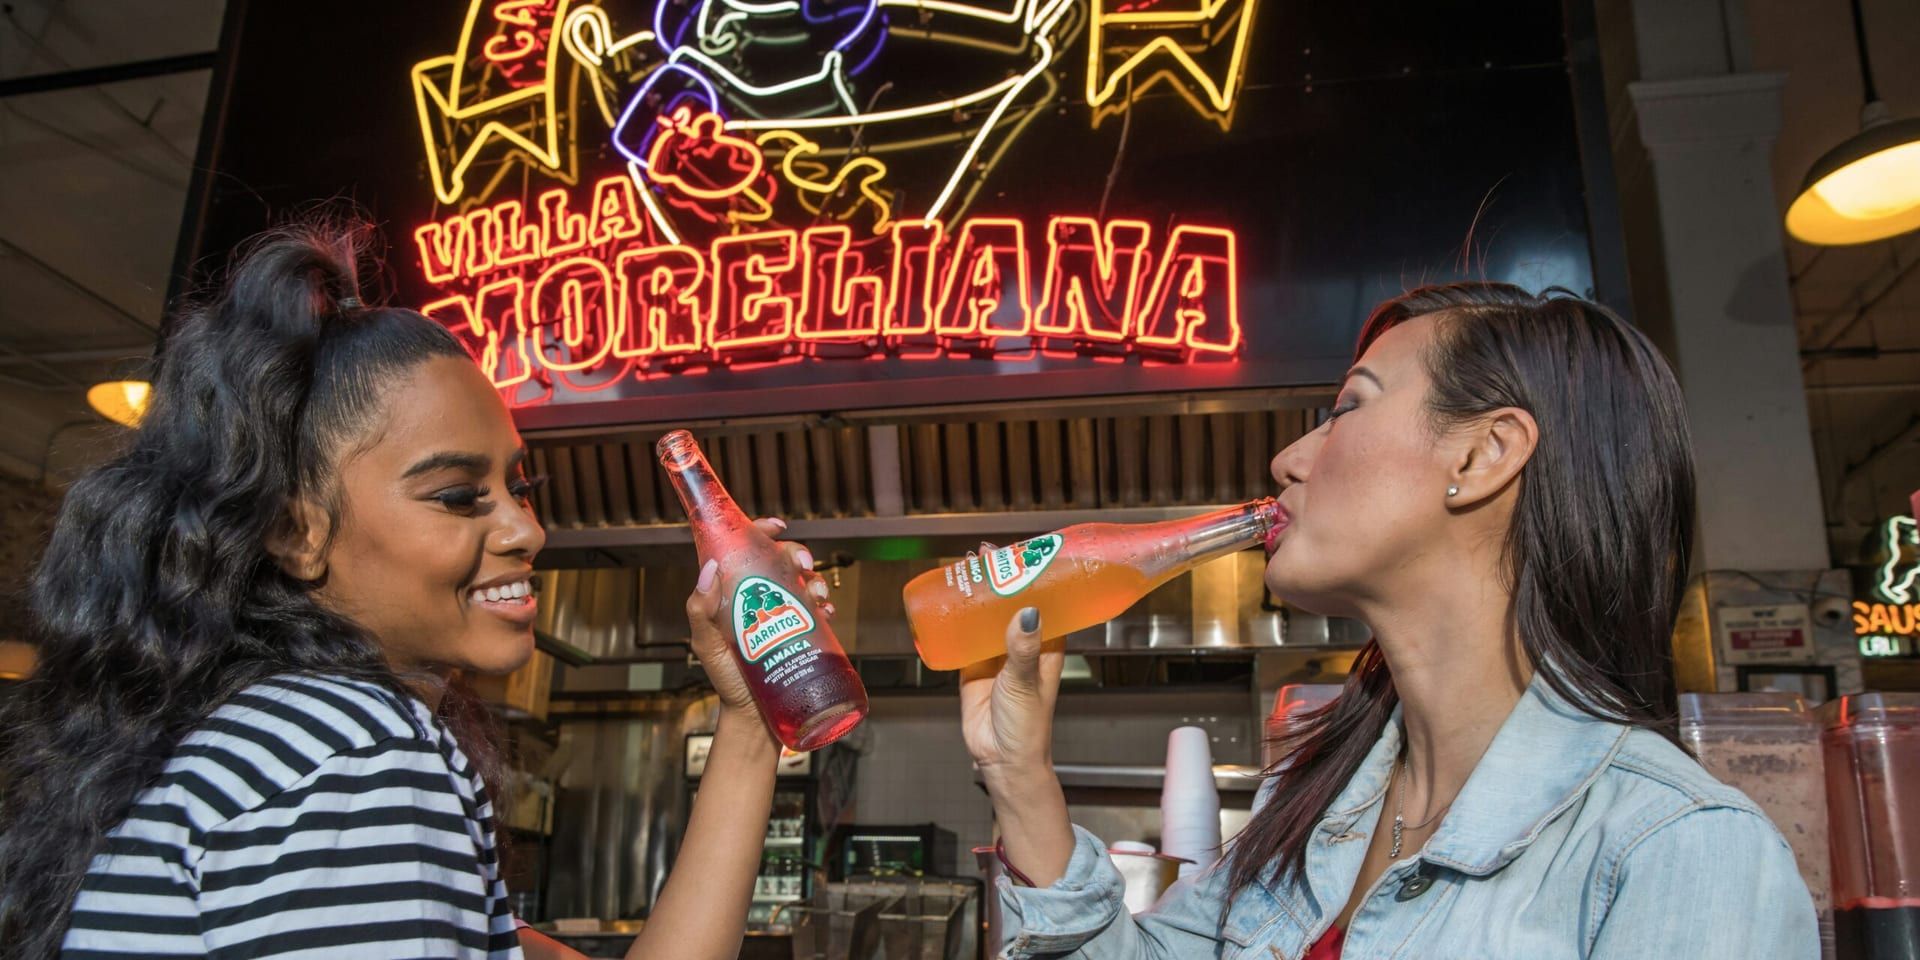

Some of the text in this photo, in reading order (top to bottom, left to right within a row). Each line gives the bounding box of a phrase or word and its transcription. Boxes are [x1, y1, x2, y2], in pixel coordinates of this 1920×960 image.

[415, 175, 642, 284] VILLA
[420, 217, 1240, 388] MORELIANA
[750, 615, 801, 650] JARRITOS
[763, 640, 811, 672] JAMAICA
[771, 672, 785, 684] WITH
[784, 664, 799, 674] REAL
[799, 655, 819, 666] SUGAR
[785, 654, 806, 667] FLAVOR
